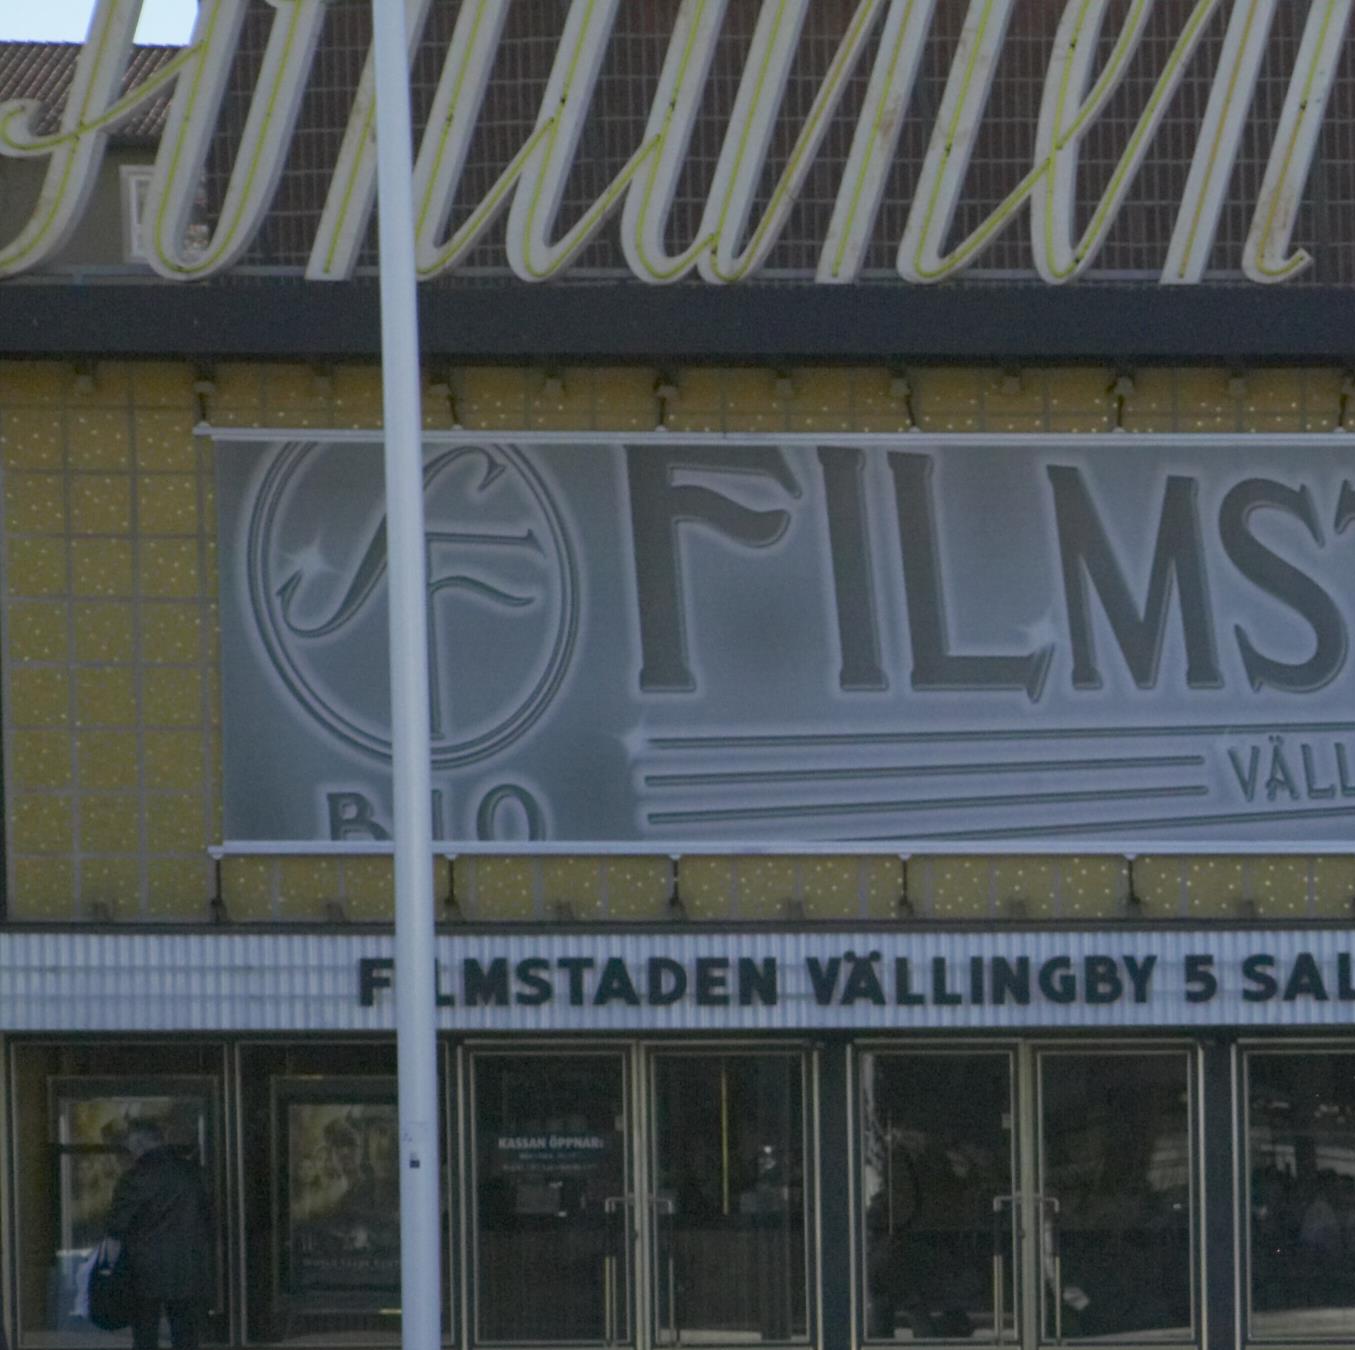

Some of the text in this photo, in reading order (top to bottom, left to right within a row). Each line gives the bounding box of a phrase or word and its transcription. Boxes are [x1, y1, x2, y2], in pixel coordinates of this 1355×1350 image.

[360, 957, 777, 1006] FLMSTADEN
[806, 950, 1158, 1005] VÄLLINGBY
[1184, 954, 1218, 1003] 5
[498, 1137, 546, 1148] KASSAN
